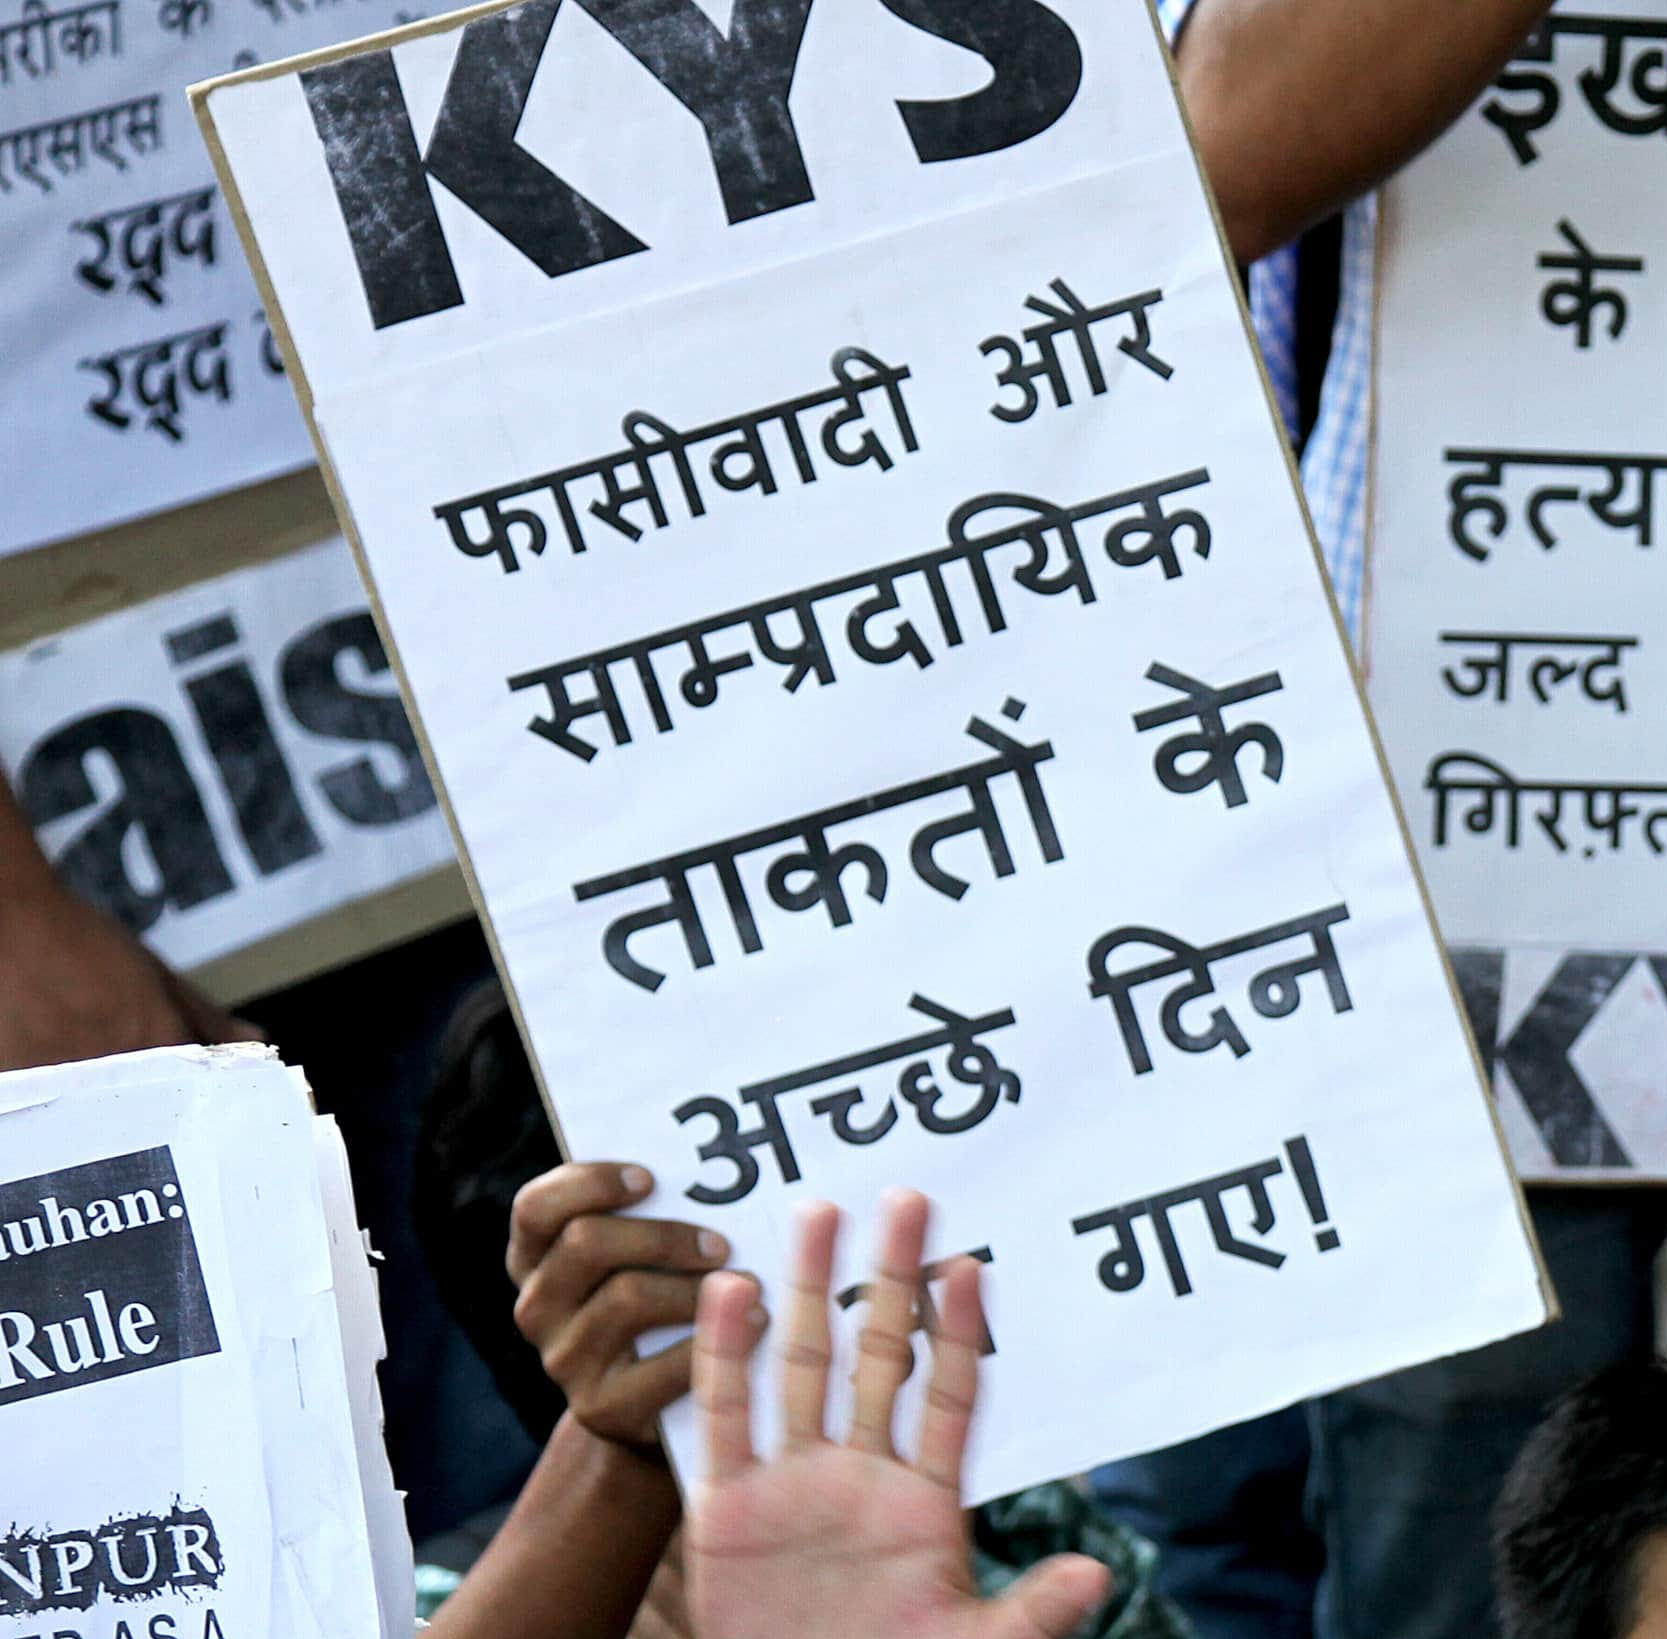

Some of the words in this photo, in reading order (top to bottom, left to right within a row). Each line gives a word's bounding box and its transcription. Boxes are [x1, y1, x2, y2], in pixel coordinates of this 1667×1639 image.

[298, 0, 1083, 331] KYS
[1537, 220, 1643, 348] के
[434, 347, 919, 575] फासीवादी
[977, 276, 1175, 425] और
[508, 467, 1211, 763] साम्प्रदायिक
[1439, 632, 1638, 713] जल्द
[573, 697, 1064, 993] ताकतों
[1131, 660, 1284, 809] के
[672, 993, 1021, 1206] अच्छे
[1088, 901, 1354, 1075] दिन
[0, 1289, 160, 1390] Rule
[1071, 1134, 1340, 1298] गए!
